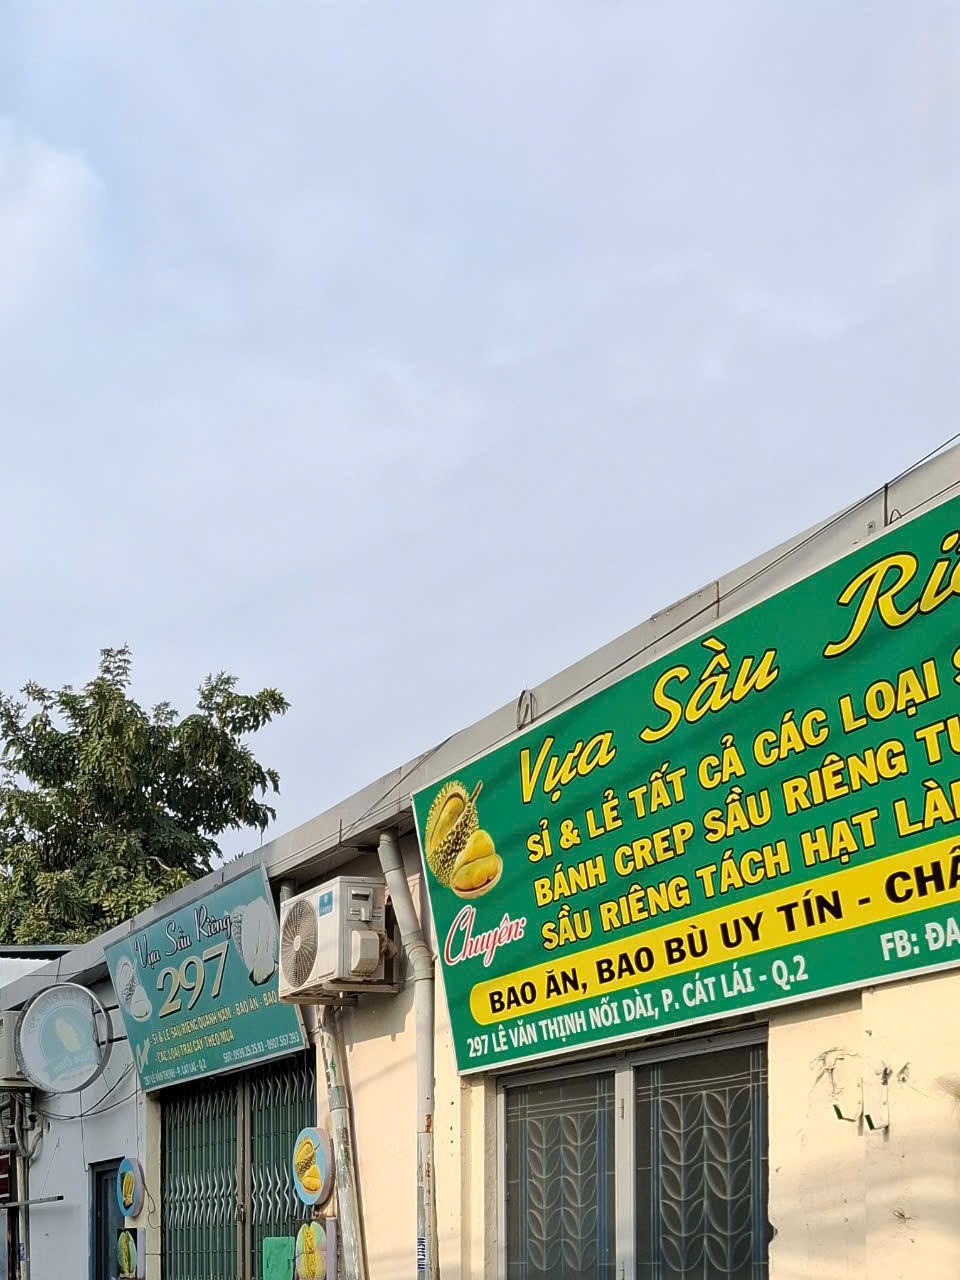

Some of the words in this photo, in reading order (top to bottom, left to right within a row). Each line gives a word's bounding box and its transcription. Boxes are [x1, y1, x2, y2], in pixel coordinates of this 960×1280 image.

[519, 730, 616, 804] Vựa
[640, 636, 779, 744] Sầu
[823, 529, 960, 659] Ri
[526, 819, 553, 863] SỈ
[559, 818, 582, 850] &
[585, 789, 623, 839] LẺ
[628, 760, 687, 820] TẤT
[697, 734, 746, 790] CẢ
[753, 709, 830, 767] CÁC
[839, 658, 940, 734] LOẠI
[533, 854, 607, 908] BÁNH
[614, 820, 694, 877] CREP
[703, 785, 772, 843] SẦU
[782, 740, 908, 815] RIÊNG
[541, 903, 592, 951] SẦU
[599, 876, 691, 933] RIÊNG
[696, 840, 790, 898] TÁCH
[800, 808, 879, 864] HẠT
[165, 920, 192, 956] Sầu
[194, 904, 232, 939] Riêng
[444, 904, 527, 967] Chuyên:
[488, 981, 536, 1013] BAO
[546, 965, 587, 995] ĂN,
[596, 947, 654, 985] BAO
[664, 925, 708, 965] BÙ
[720, 912, 763, 949] UY
[777, 889, 843, 932] TÍN
[880, 931, 920, 961] FB:
[156, 941, 229, 1017] 297
[235, 1000, 248, 1016] BAO
[263, 990, 277, 1006] BAO
[467, 1035, 489, 1058] 297
[492, 1027, 507, 1052] LÊ
[510, 1018, 532, 1048] VĂN
[539, 1010, 587, 1042] THỊNH
[590, 996, 621, 1029] NỐI
[623, 989, 659, 1021] DÀI,
[661, 988, 680, 1012] P.
[682, 972, 716, 1007] CÁT
[721, 961, 755, 999] LÁI
[771, 954, 809, 990] Q.2
[204, 1033, 220, 1048] THEO
